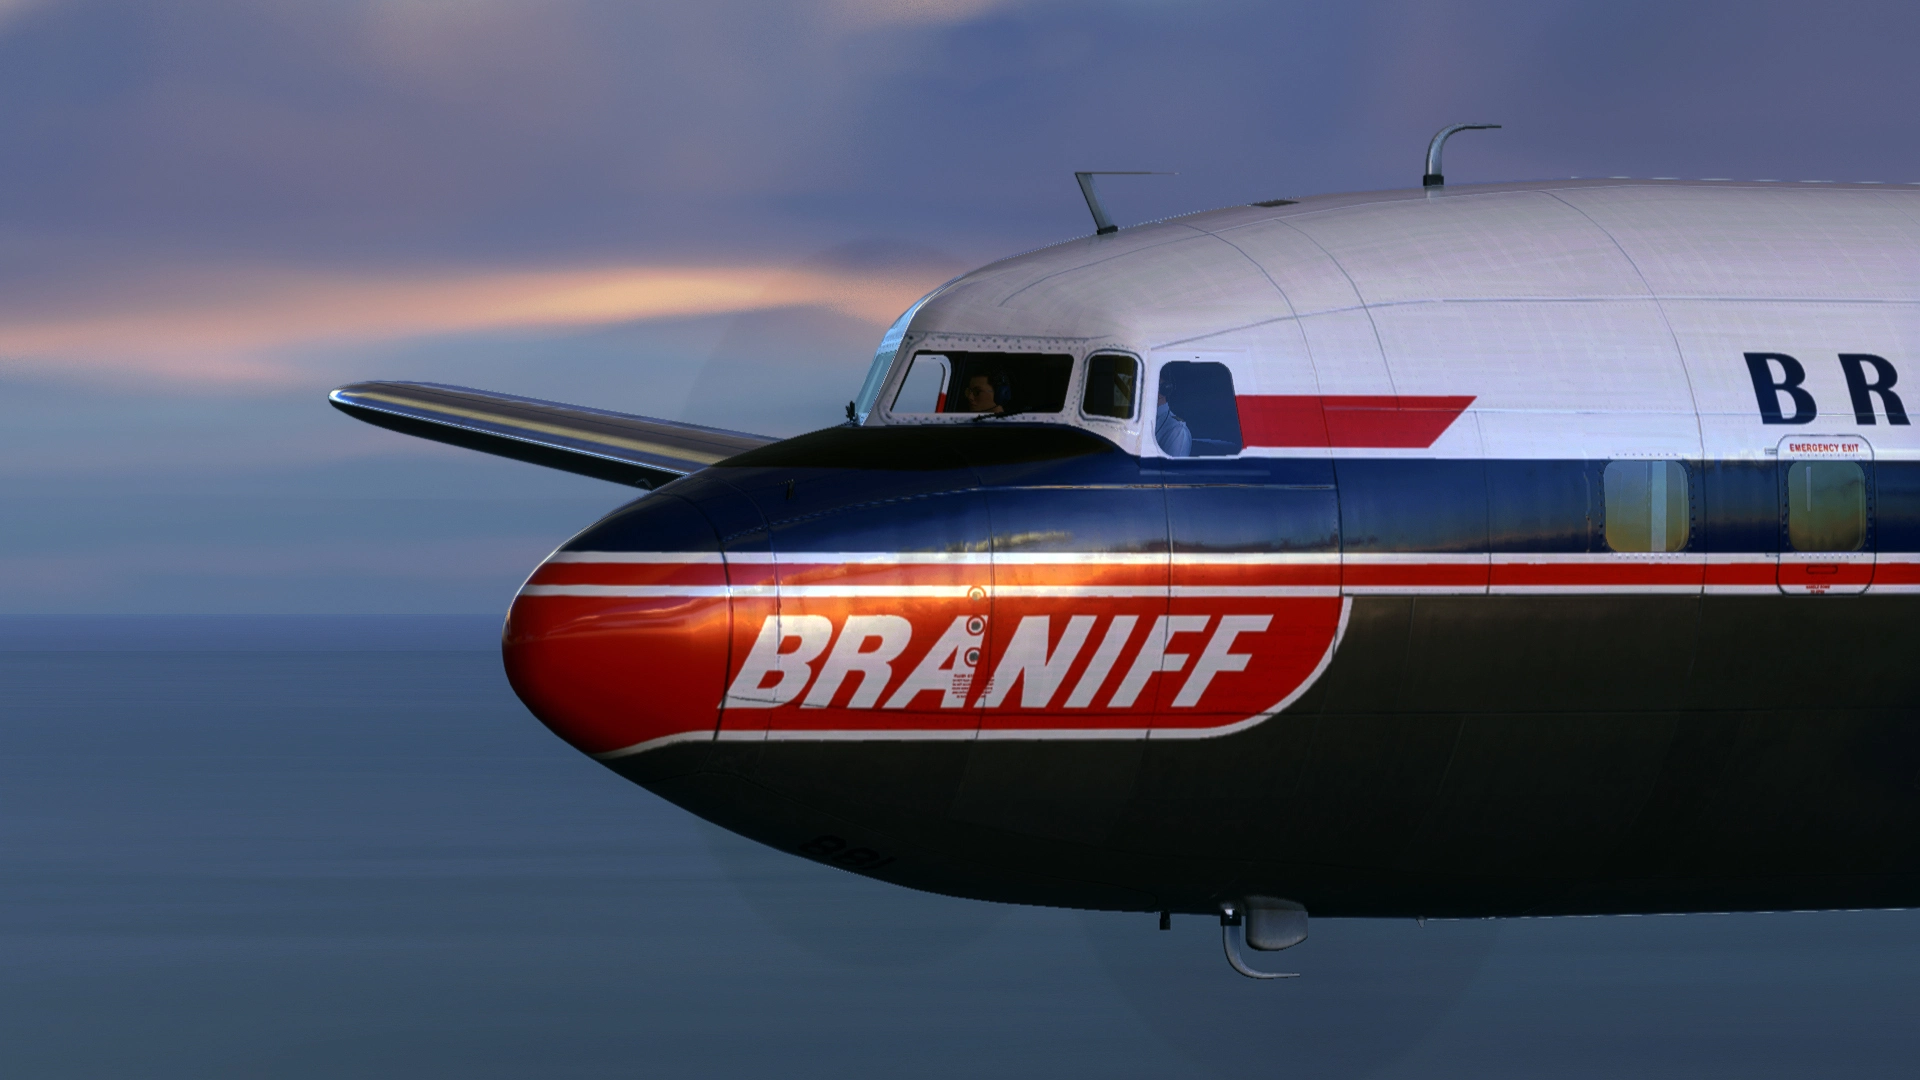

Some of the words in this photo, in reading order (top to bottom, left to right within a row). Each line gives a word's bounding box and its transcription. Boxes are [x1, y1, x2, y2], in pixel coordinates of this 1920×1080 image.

[1789, 443, 1839, 453] EMERGENCY
[1841, 443, 1860, 453] EXIT
[717, 614, 1274, 710] BRANIFF
